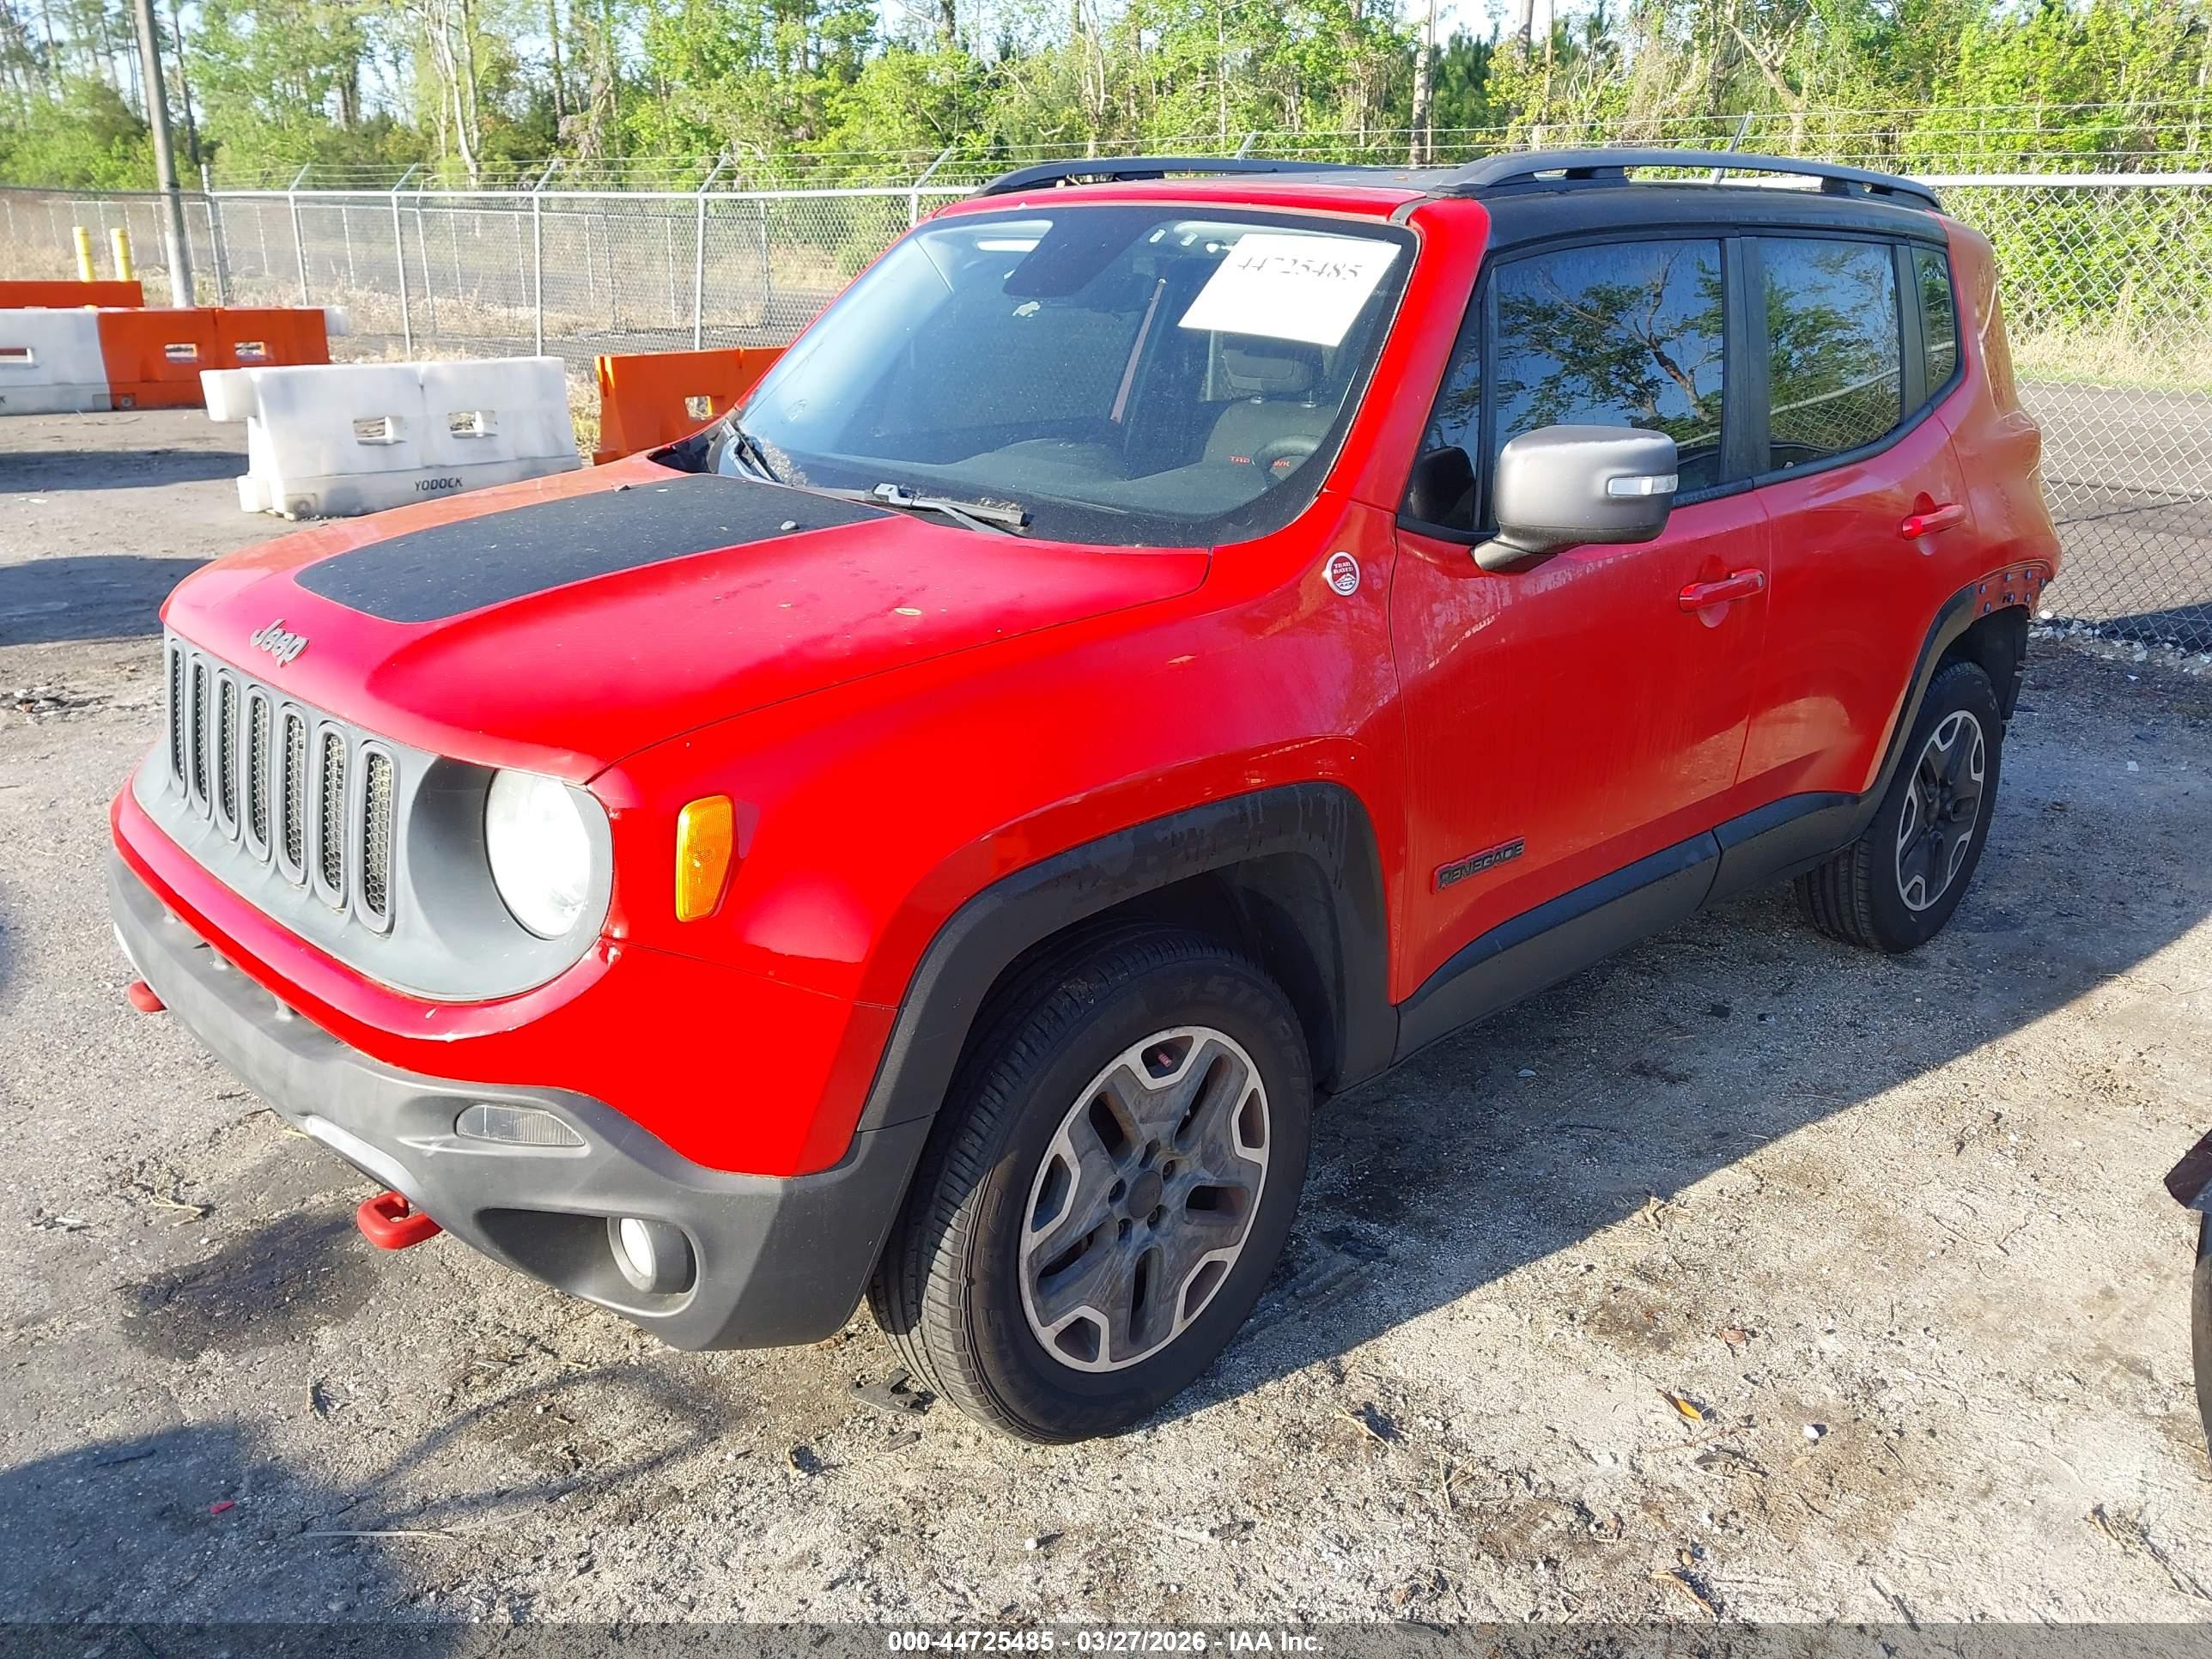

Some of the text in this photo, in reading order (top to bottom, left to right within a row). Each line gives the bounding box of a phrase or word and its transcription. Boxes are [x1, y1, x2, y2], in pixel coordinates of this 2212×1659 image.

[415, 477, 463, 492] YODOCK
[250, 618, 310, 668] Jeep
[1436, 841, 1525, 891] RENEGADE
